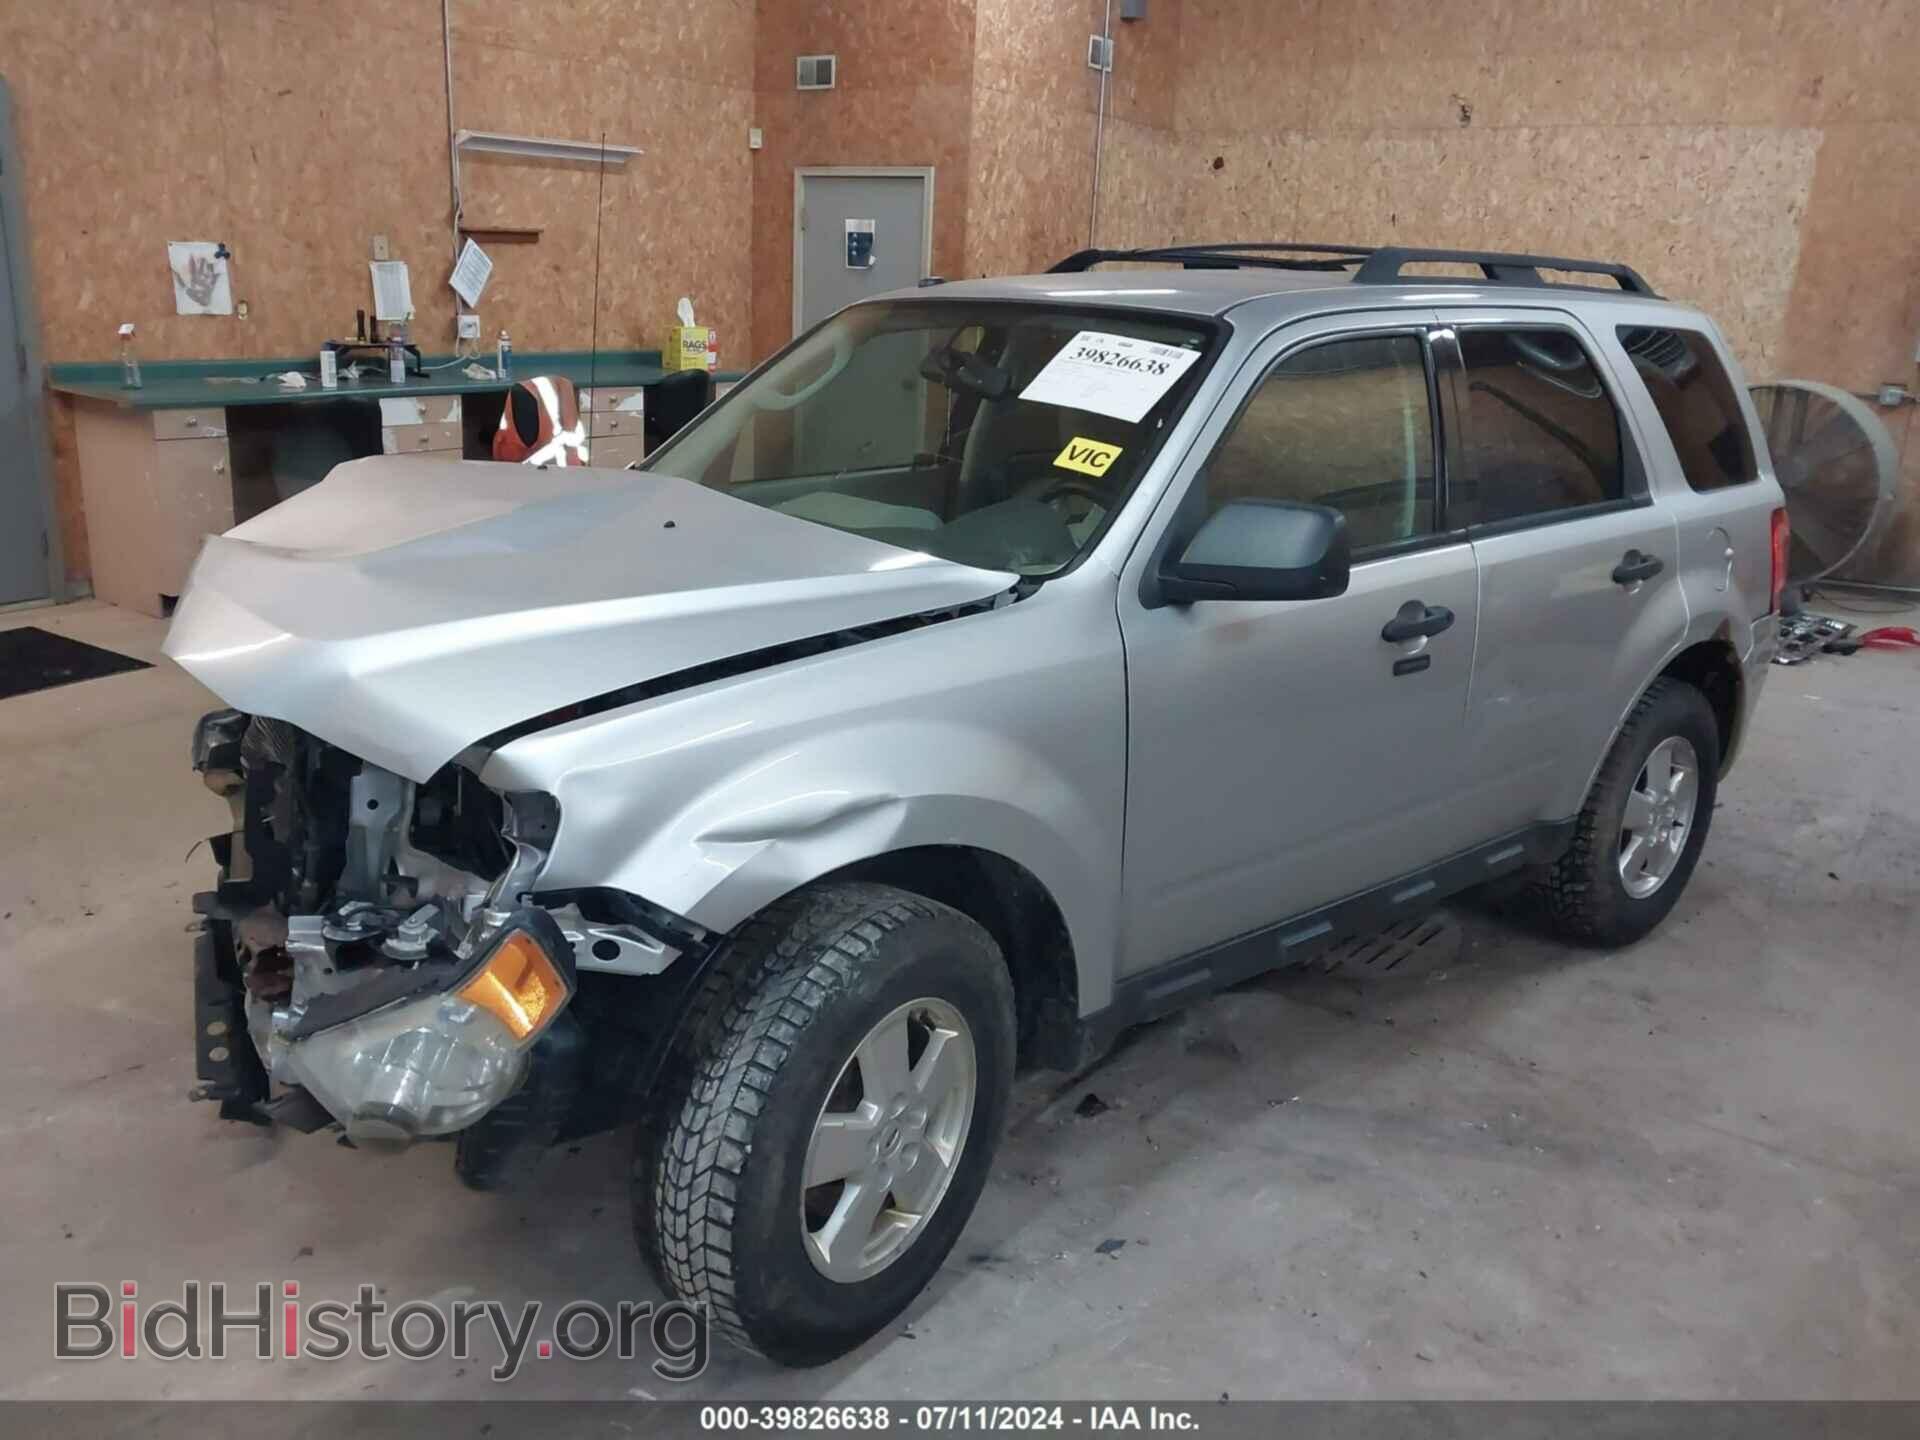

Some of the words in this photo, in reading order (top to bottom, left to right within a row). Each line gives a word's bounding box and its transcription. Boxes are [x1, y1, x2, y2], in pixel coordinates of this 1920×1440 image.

[682, 340, 706, 349] RAGS
[1069, 346, 1170, 376] 39826638
[1067, 444, 1111, 468] VIC
